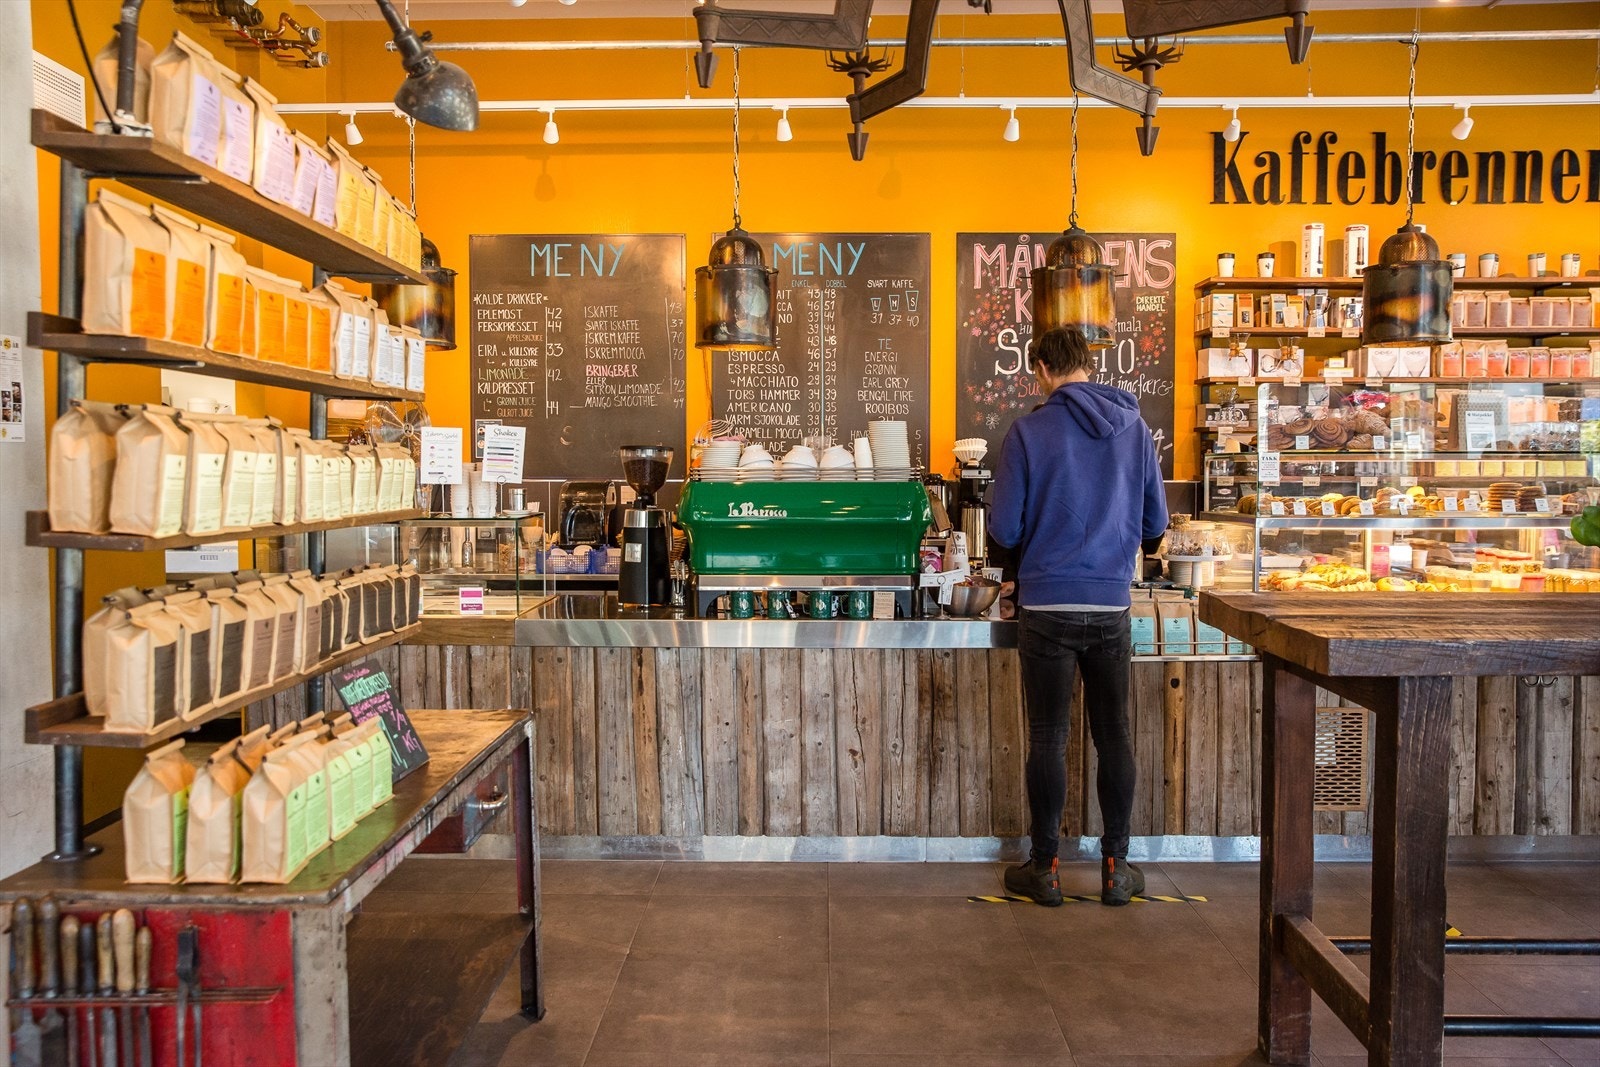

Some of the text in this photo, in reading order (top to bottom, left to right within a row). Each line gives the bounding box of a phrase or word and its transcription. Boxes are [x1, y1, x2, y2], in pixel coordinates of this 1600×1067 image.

[531, 243, 625, 277] MENY
[773, 242, 866, 276] MENY
[867, 279, 914, 289] SVART KAFFE
[475, 292, 543, 305] KALDE DRIKKER
[807, 288, 821, 299] 43
[824, 288, 837, 299] 48
[1135, 295, 1166, 305] DIREKTE
[807, 300, 820, 311] 46
[824, 300, 835, 311] 51
[910, 297, 916, 307] S
[1136, 303, 1166, 312] HANDEL
[477, 307, 563, 320] EPLEMOST 42
[584, 305, 619, 319] ISKAFFE
[807, 311, 819, 323] 39
[824, 311, 835, 322] 44
[584, 320, 608, 331] SVART
[610, 319, 640, 331] ISKAFFE
[888, 313, 902, 326] 37
[906, 315, 920, 327] 40
[477, 320, 562, 333] FERSKPRESSET 44
[807, 323, 836, 335] 39 44
[671, 331, 685, 344] 70
[807, 335, 820, 347] 43
[878, 338, 892, 350] TE
[477, 344, 498, 357] EIRA
[508, 346, 539, 356] KULLSYRE
[546, 343, 563, 357] 33
[672, 348, 685, 361] 70
[727, 350, 780, 362] ISMOCCA
[807, 348, 821, 360] 46
[864, 351, 898, 362] ENERGI
[509, 358, 539, 367] KULLSYRE
[727, 360, 837, 375] ESPRESSO 24 29
[478, 367, 563, 382] LIMONADE 42
[585, 363, 639, 378] BRINGEBÆR
[864, 364, 897, 375] GRØNN
[585, 376, 607, 386] ELLER
[736, 375, 799, 388] MACCHIATO
[824, 374, 837, 386] 34
[862, 376, 910, 389] EARL GREY
[477, 381, 535, 395] KALDPRESSET
[584, 384, 617, 396] SITRON
[618, 383, 663, 395] LIMONADE
[727, 388, 837, 401] TORS HAMMER 34 39
[584, 396, 612, 409] MANGO
[613, 395, 658, 408] SMOOTHIE
[857, 389, 915, 402] BENGAL FIRE
[518, 396, 536, 406] JUICE
[546, 400, 559, 416] 44
[726, 401, 837, 413] AMERICANO 30 35
[865, 403, 910, 415] ROOIBOS
[725, 414, 837, 426] VARM SJOKOLADE 39 45
[726, 427, 774, 439] KARAMELL
[775, 428, 803, 439] MOCCA
[914, 429, 922, 440] 5
[739, 501, 788, 518] Marzocco
